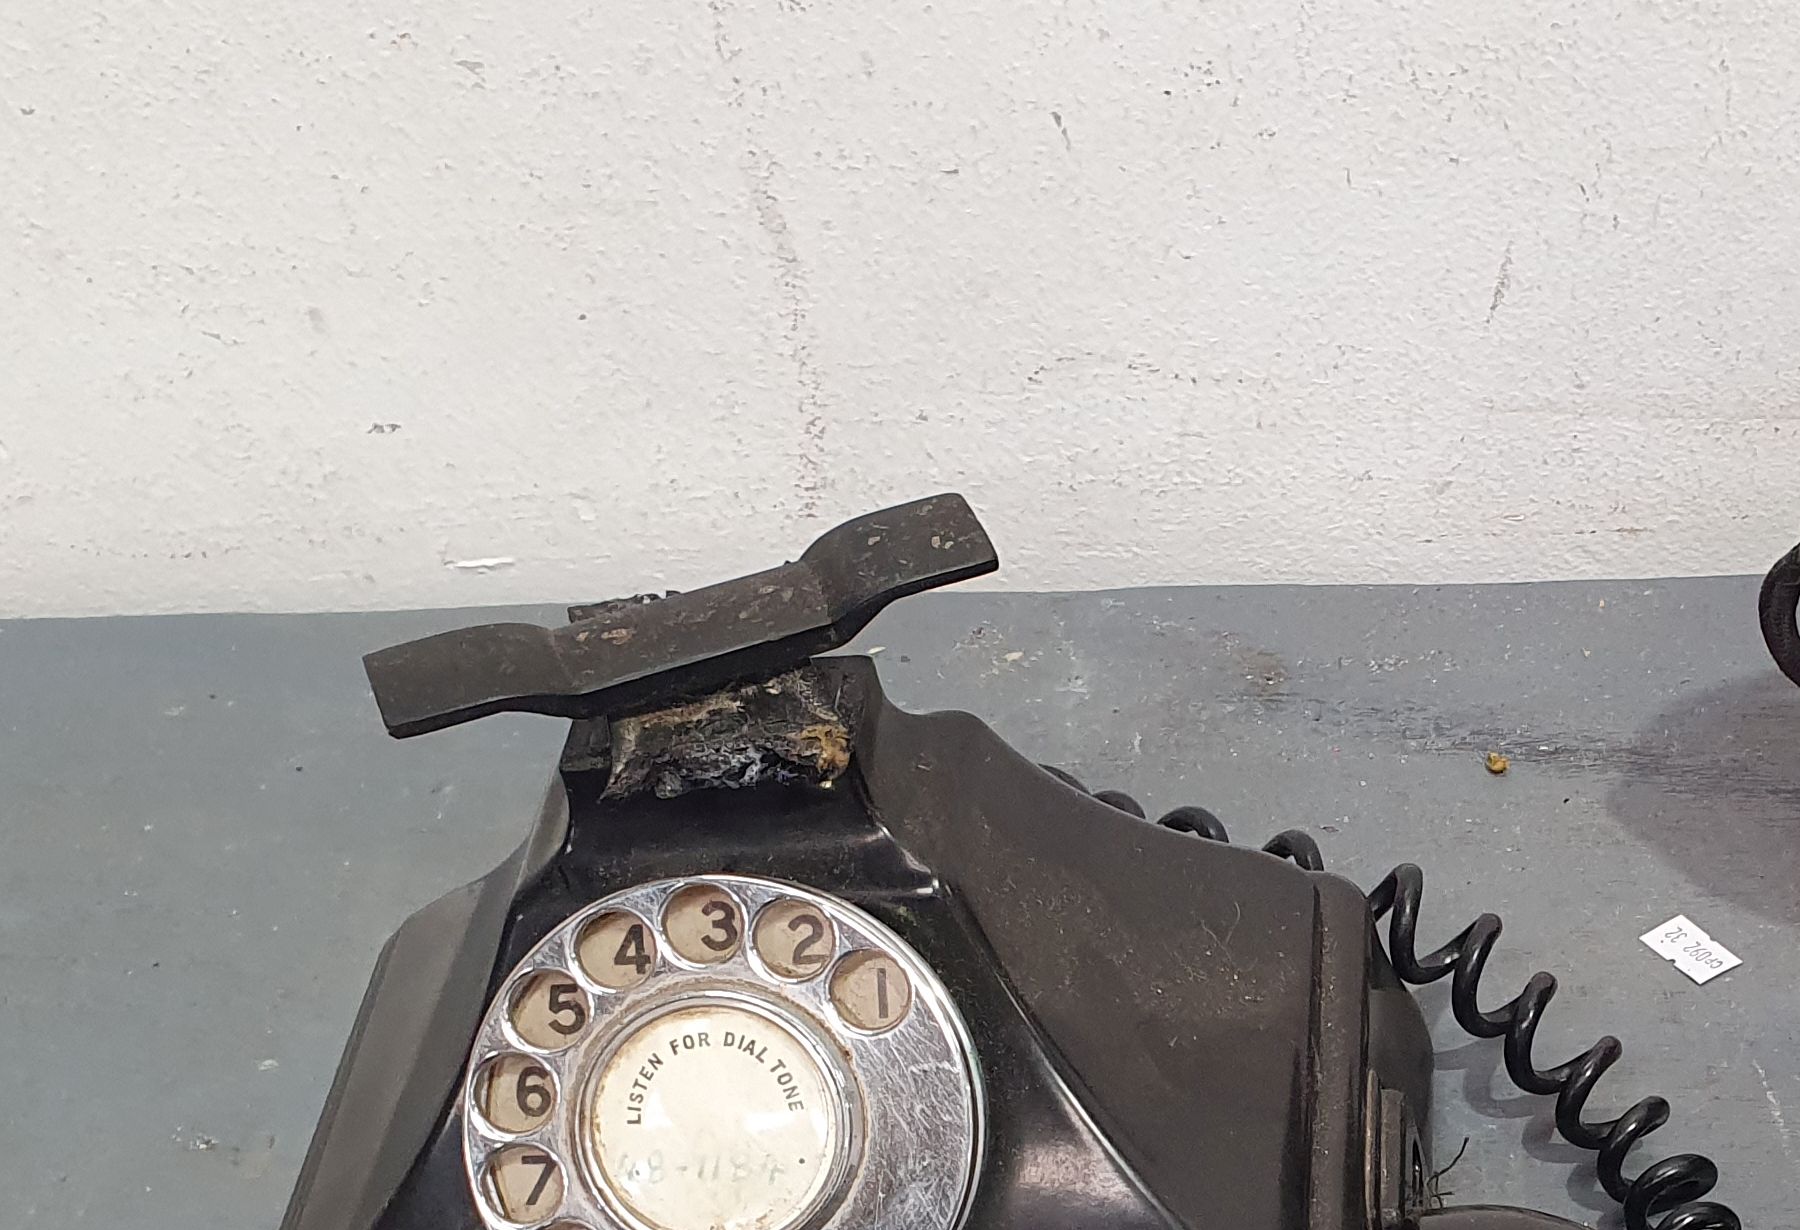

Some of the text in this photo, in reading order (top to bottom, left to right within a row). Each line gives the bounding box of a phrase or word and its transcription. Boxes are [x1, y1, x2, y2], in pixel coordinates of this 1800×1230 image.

[614, 923, 651, 975] 4
[701, 899, 739, 952] 3
[792, 914, 825, 965] 2
[1665, 927, 1687, 943] 32
[548, 984, 585, 1036] 5
[877, 967, 887, 1020] 1
[516, 1066, 551, 1118] 6
[626, 1031, 805, 1126] LISTEN FOR DIAL TONE
[520, 1155, 556, 1206] 7
